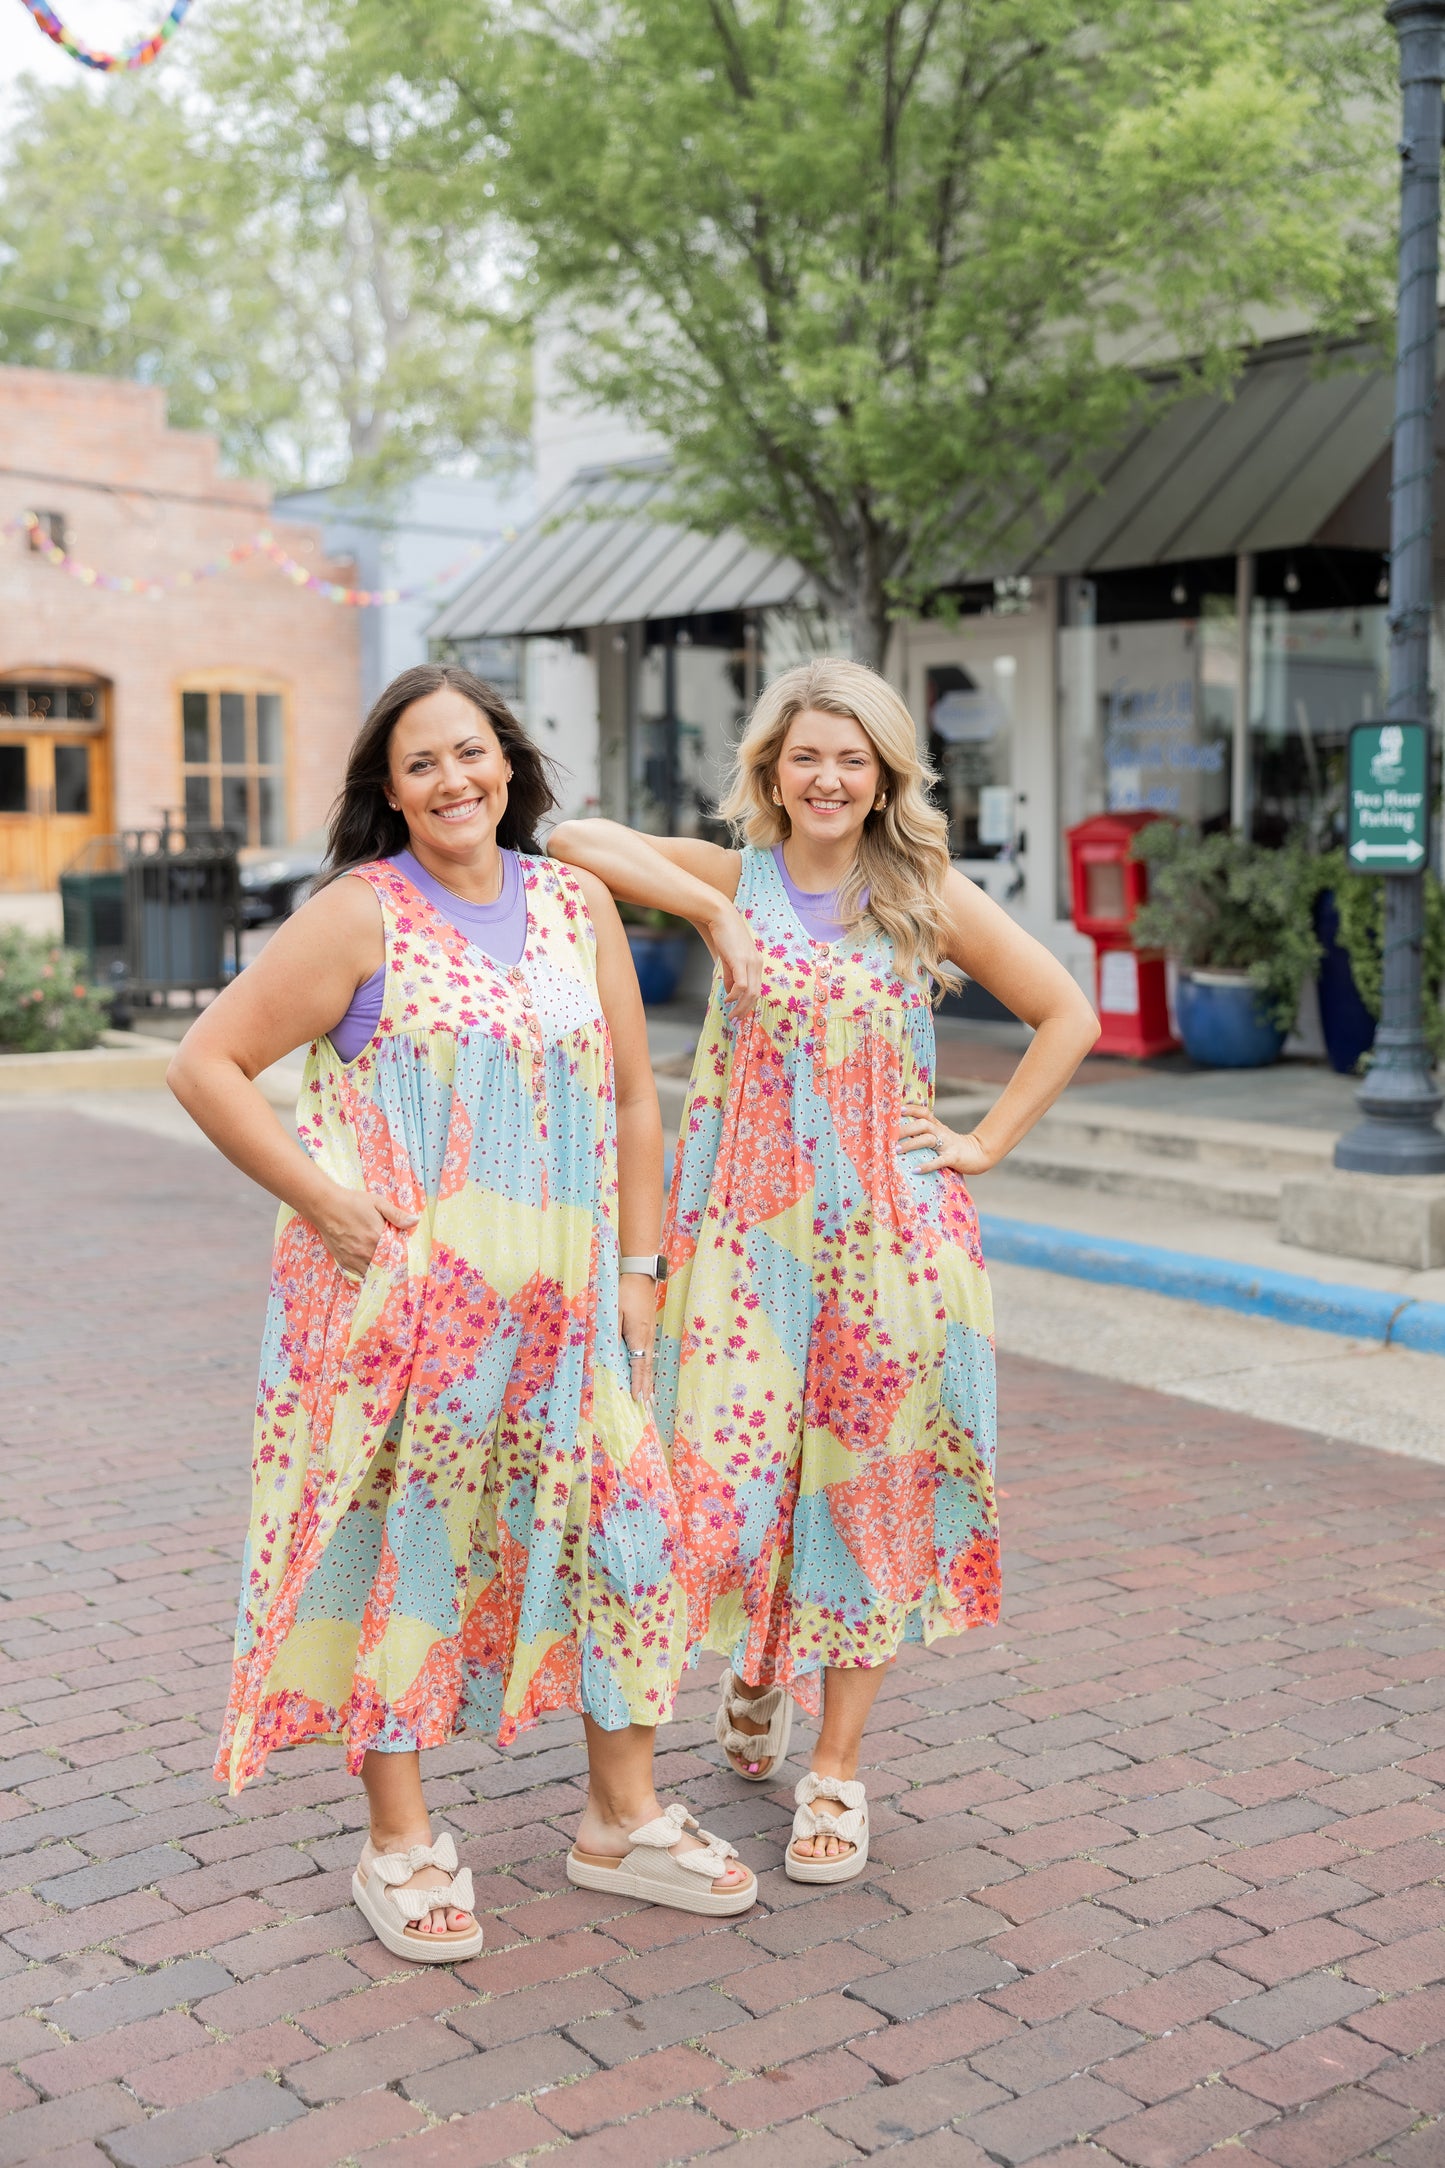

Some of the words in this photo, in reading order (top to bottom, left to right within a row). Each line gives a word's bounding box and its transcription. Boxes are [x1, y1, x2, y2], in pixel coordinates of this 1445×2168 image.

[1353, 790, 1382, 808] Two
[1384, 790, 1422, 808] Hour
[1359, 807, 1415, 833] Parking
